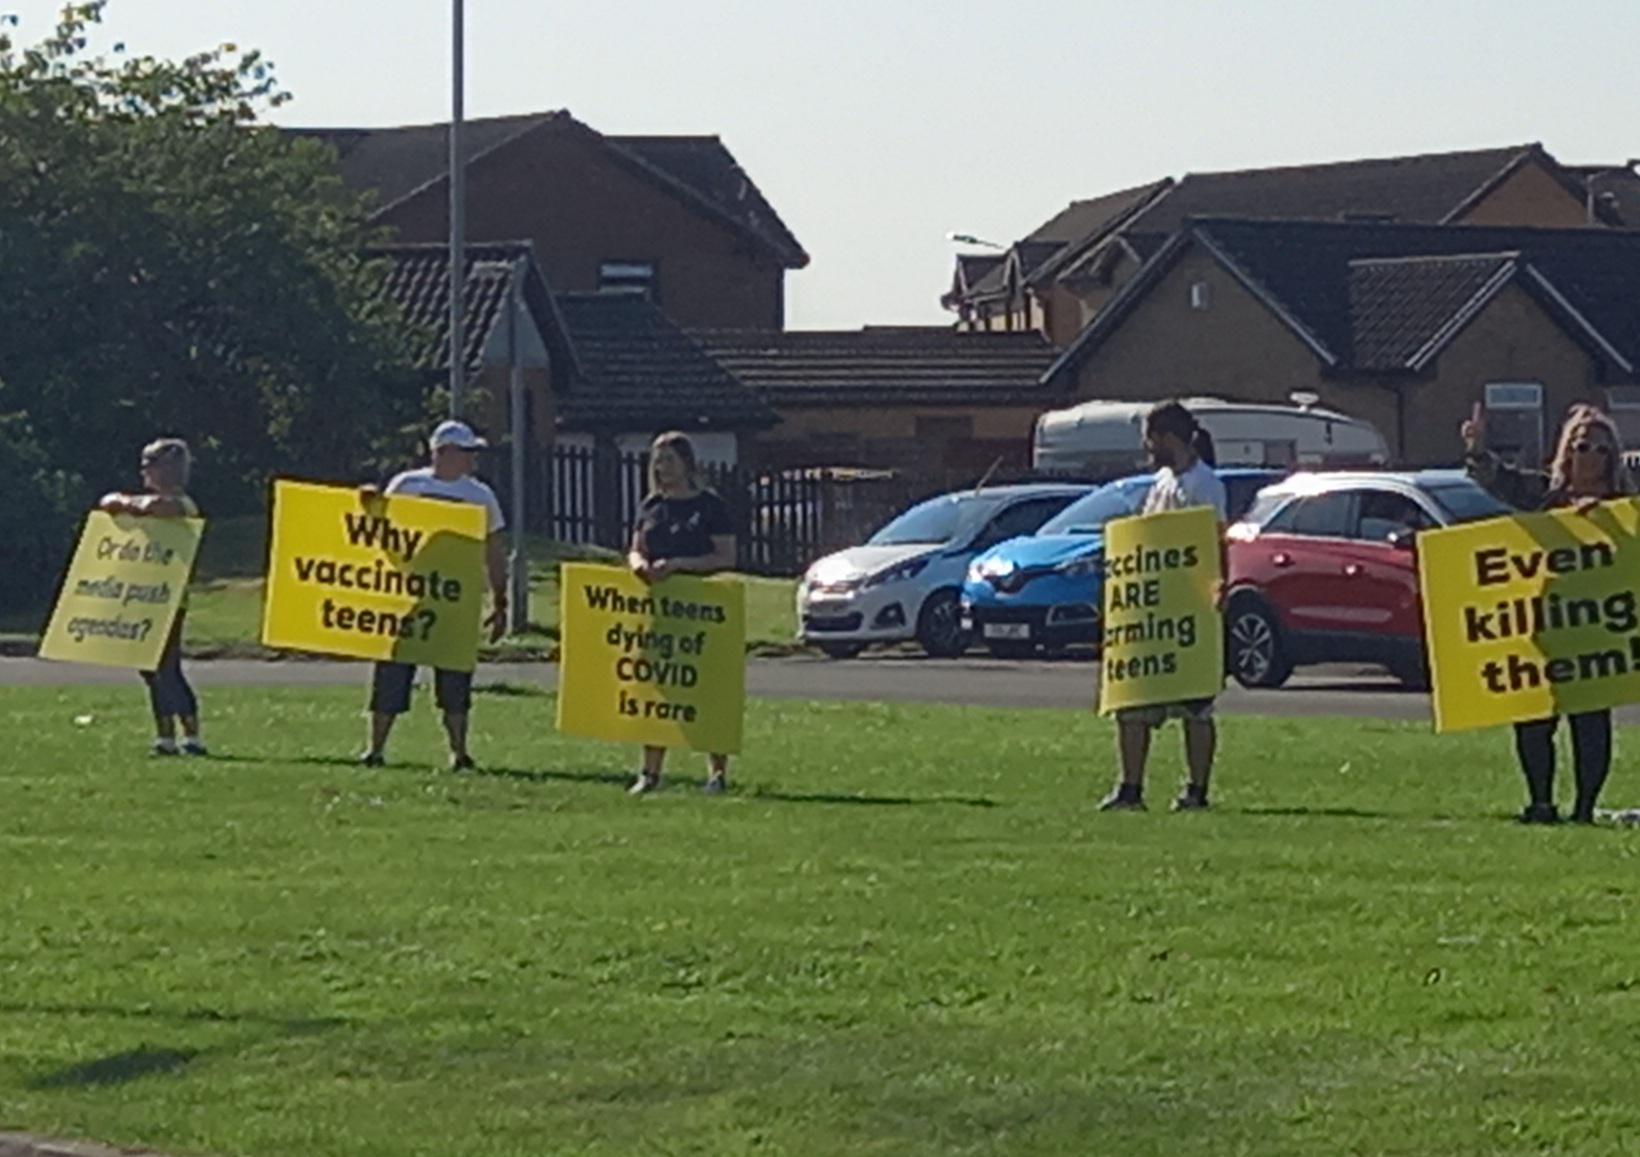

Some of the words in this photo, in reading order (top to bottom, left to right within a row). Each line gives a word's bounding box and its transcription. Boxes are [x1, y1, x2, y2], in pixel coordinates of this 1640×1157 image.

[344, 512, 423, 562] Why
[295, 557, 461, 602] vaccinate
[1475, 541, 1614, 586] Even
[584, 585, 655, 615] When
[661, 597, 726, 623] teens
[1110, 580, 1160, 611] ARE
[322, 599, 437, 640] teens?
[1464, 590, 1638, 642] killing
[606, 622, 673, 659] dying
[680, 632, 705, 654] of
[616, 657, 698, 687] COVID
[619, 690, 638, 716] is
[644, 700, 696, 722] rare
